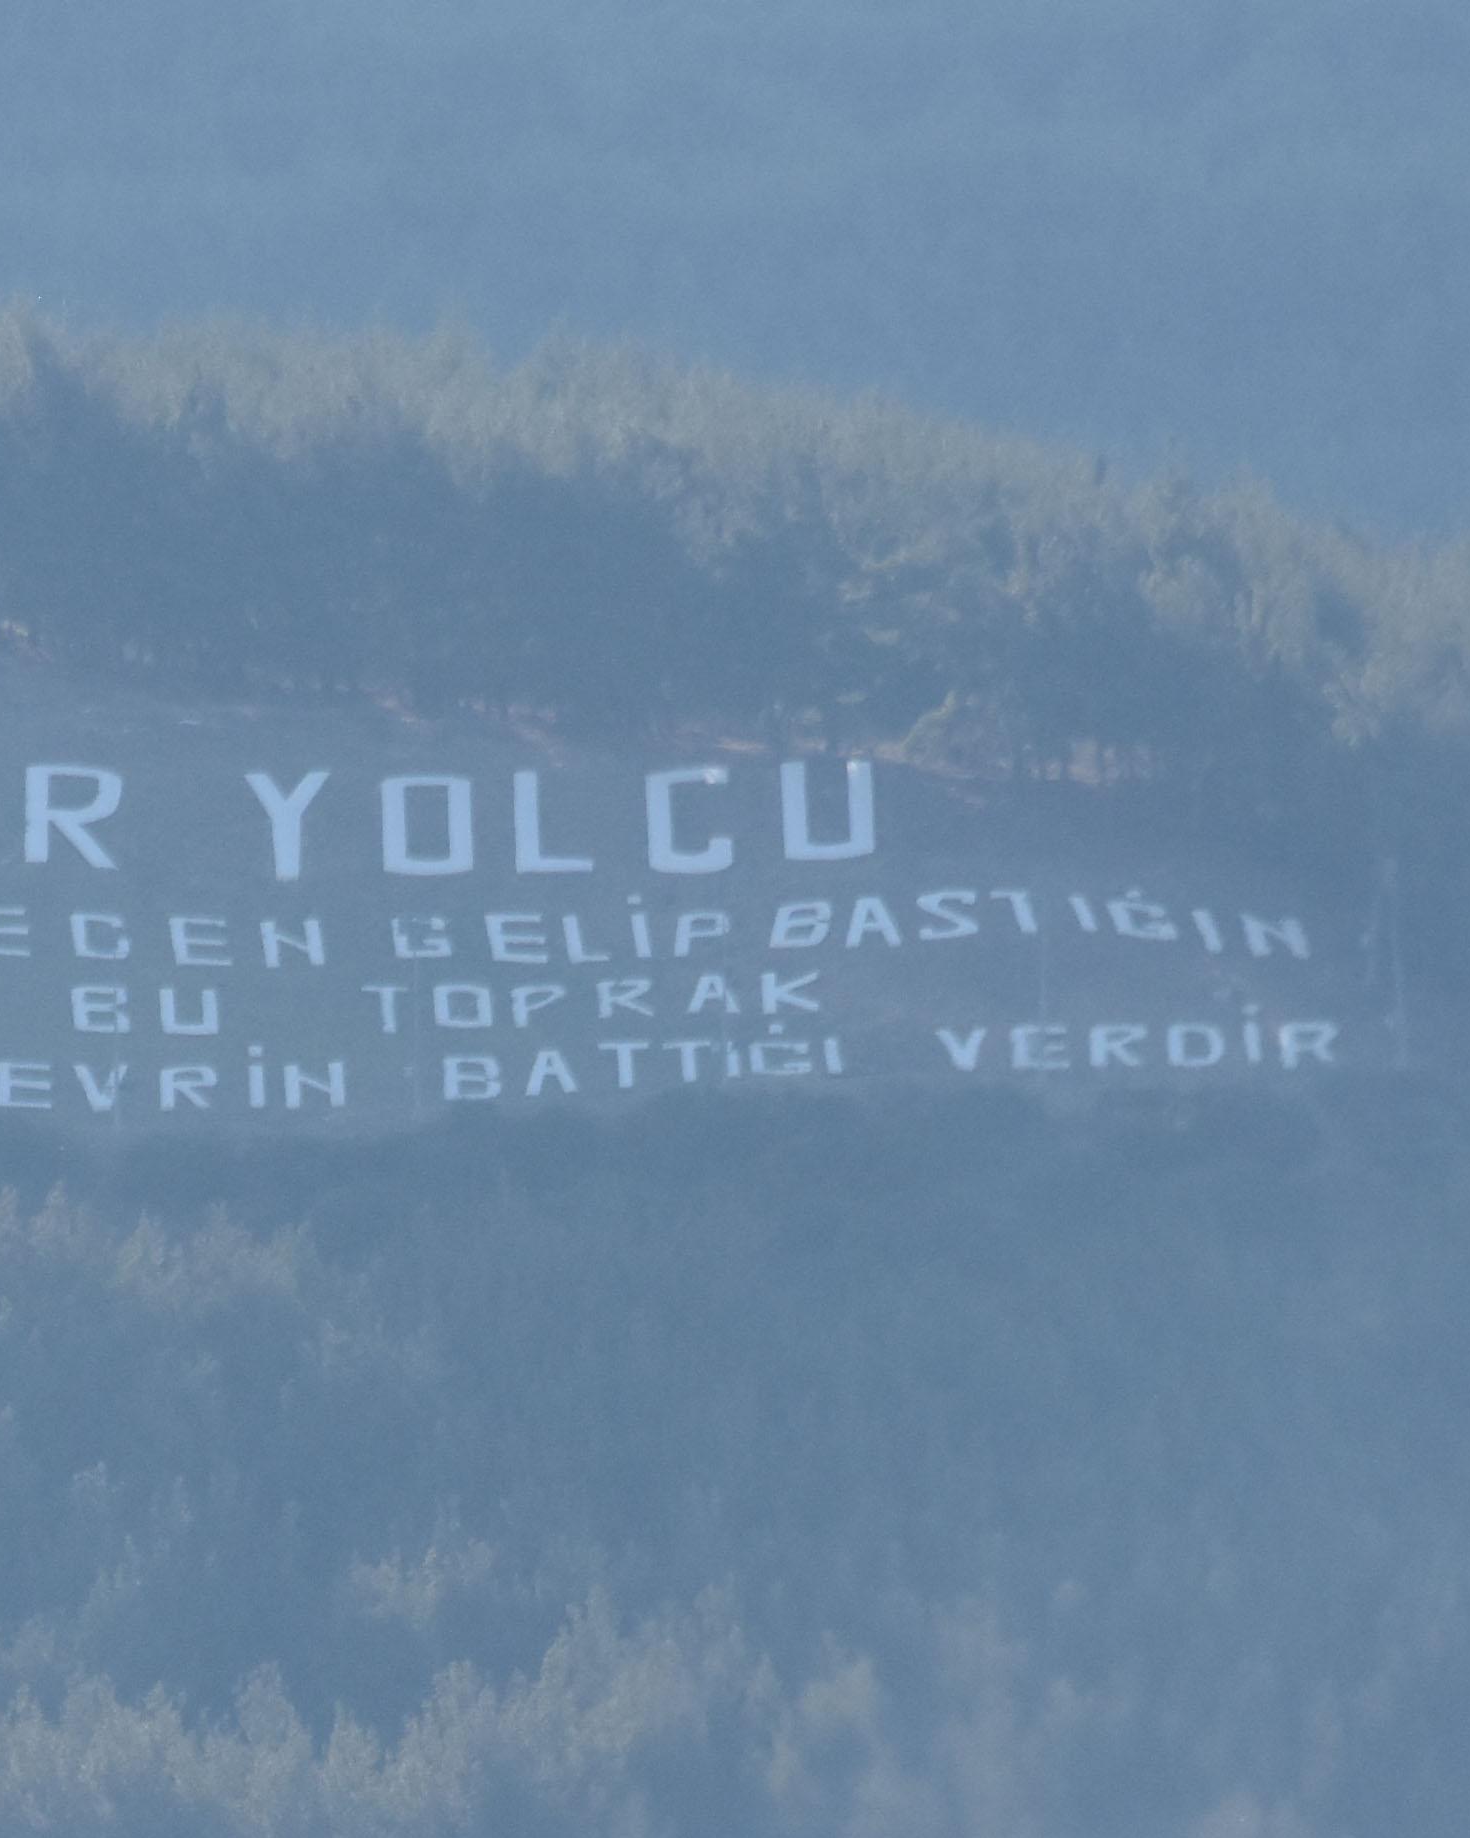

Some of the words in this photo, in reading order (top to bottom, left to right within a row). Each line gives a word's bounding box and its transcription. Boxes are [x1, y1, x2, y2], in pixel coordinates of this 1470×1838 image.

[245, 761, 876, 882] YOLCU
[71, 985, 220, 1036] BU
[361, 970, 822, 1034] TOPRAK
